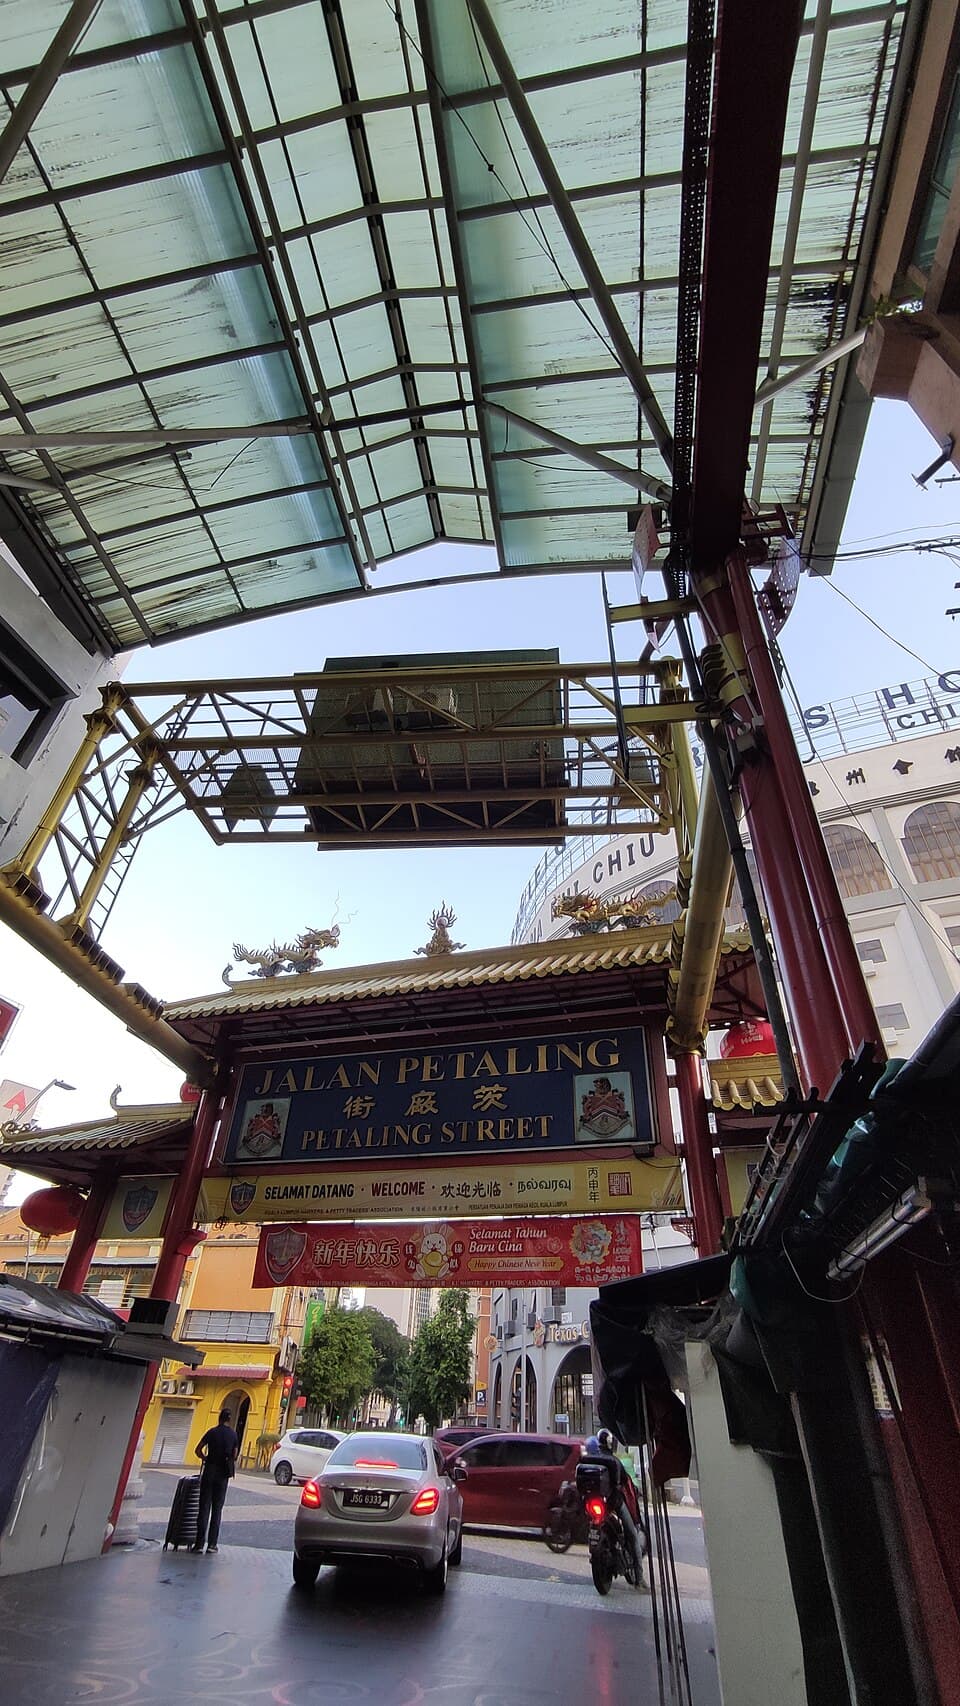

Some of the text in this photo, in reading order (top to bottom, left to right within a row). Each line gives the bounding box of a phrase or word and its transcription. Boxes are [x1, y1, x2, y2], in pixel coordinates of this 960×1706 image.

[592, 832, 655, 884] CHIU
[254, 1037, 621, 1095] JALAN PETALING
[301, 1115, 554, 1150] PETALING STREET
[264, 1181, 425, 1200] SELAMAT DATANG WELCOME
[440, 1182, 501, 1199] 欢迎光临
[470, 1226, 547, 1240] Selamat Tahun
[312, 1239, 400, 1268] 新年快乐
[469, 1240, 523, 1253] Baru Cina
[474, 1259, 556, 1270] Happy Chinese New Year
[549, 1324, 577, 1342] Texas
